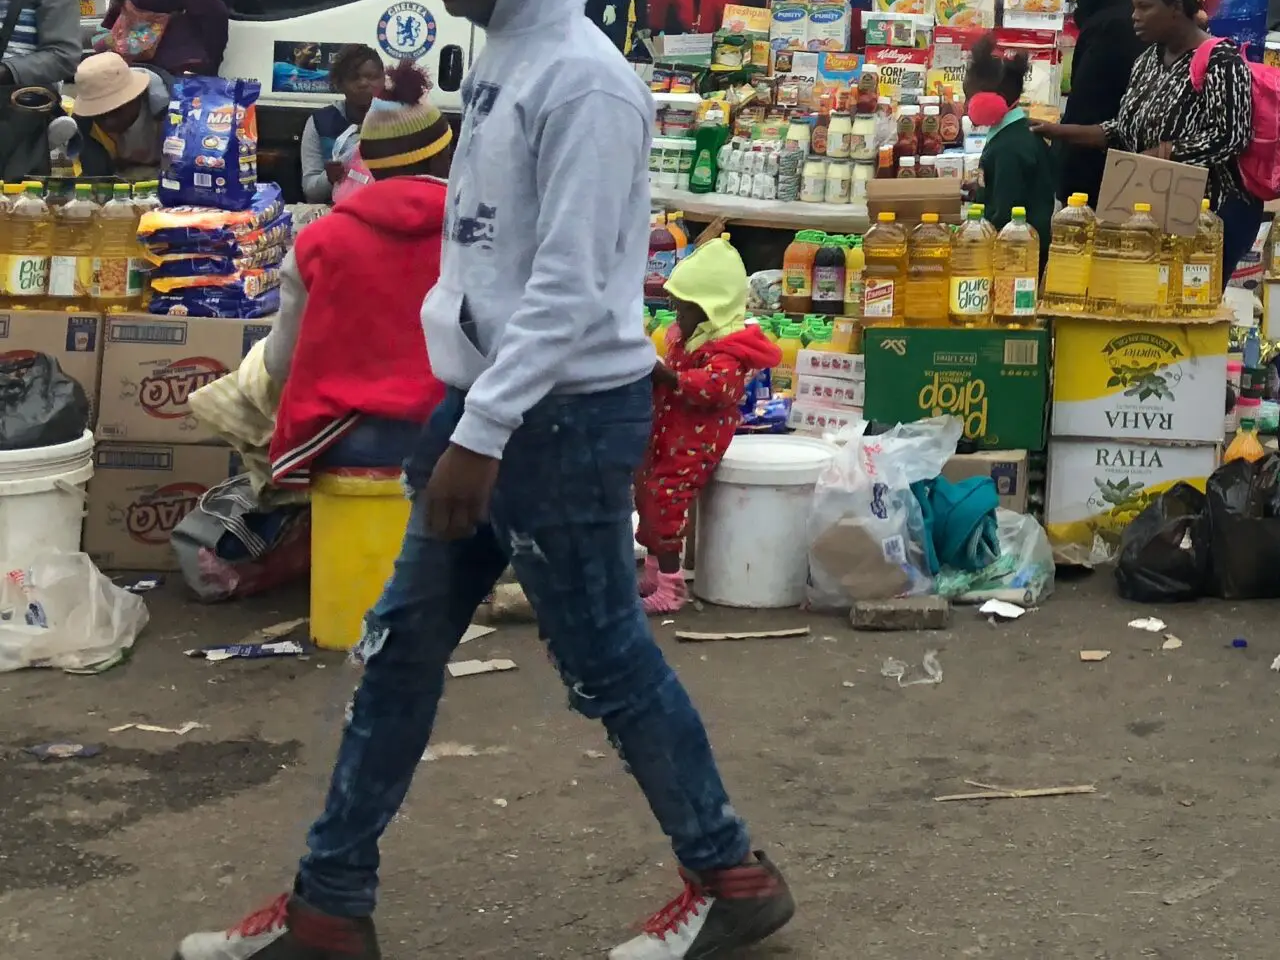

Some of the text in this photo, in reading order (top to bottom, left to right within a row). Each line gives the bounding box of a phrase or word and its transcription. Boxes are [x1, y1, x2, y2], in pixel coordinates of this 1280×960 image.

[387, 2, 427, 17] CHELSEA
[877, 49, 913, 62] Kellogg's
[880, 76, 901, 85] FLAKE
[944, 73, 964, 82] FLAKE
[1185, 264, 1208, 273] RAHA
[958, 277, 989, 300] pure
[959, 291, 989, 313] drop
[918, 372, 985, 416] drop
[1104, 411, 1174, 430] RAHA
[1095, 448, 1163, 468] RAHA
